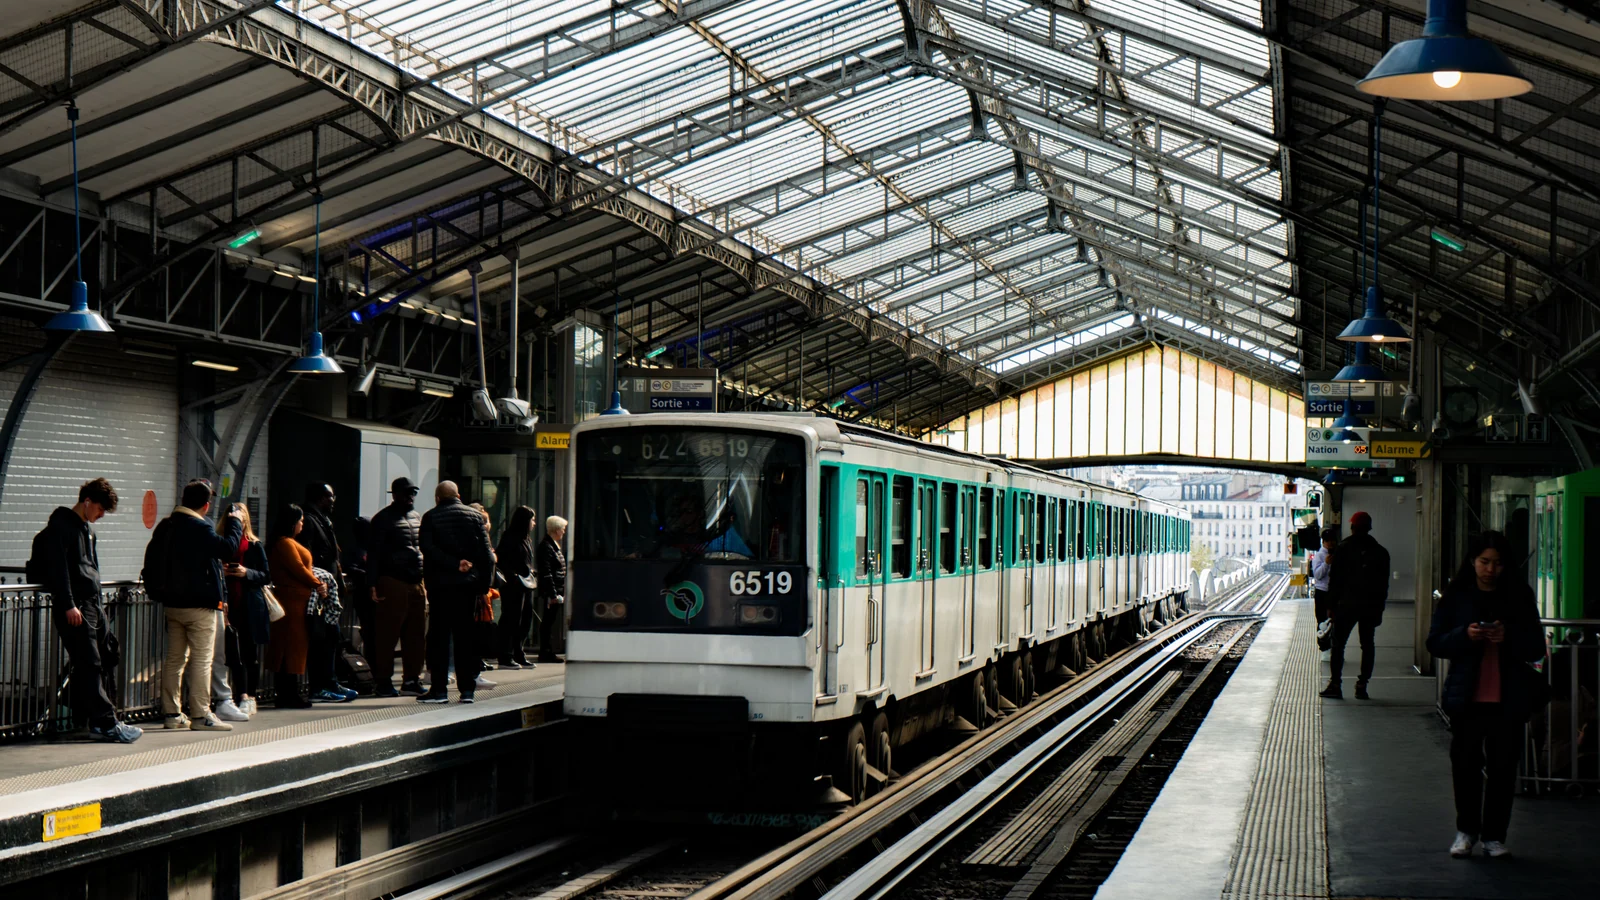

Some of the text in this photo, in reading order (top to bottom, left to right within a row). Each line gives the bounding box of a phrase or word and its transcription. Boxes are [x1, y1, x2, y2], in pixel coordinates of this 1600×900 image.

[651, 398, 683, 408] Sortie
[1309, 402, 1343, 412] Sortie
[699, 439, 749, 458] 6519
[1308, 445, 1338, 454] Nation
[1376, 444, 1414, 454] Alarme
[729, 570, 792, 595] 6519
